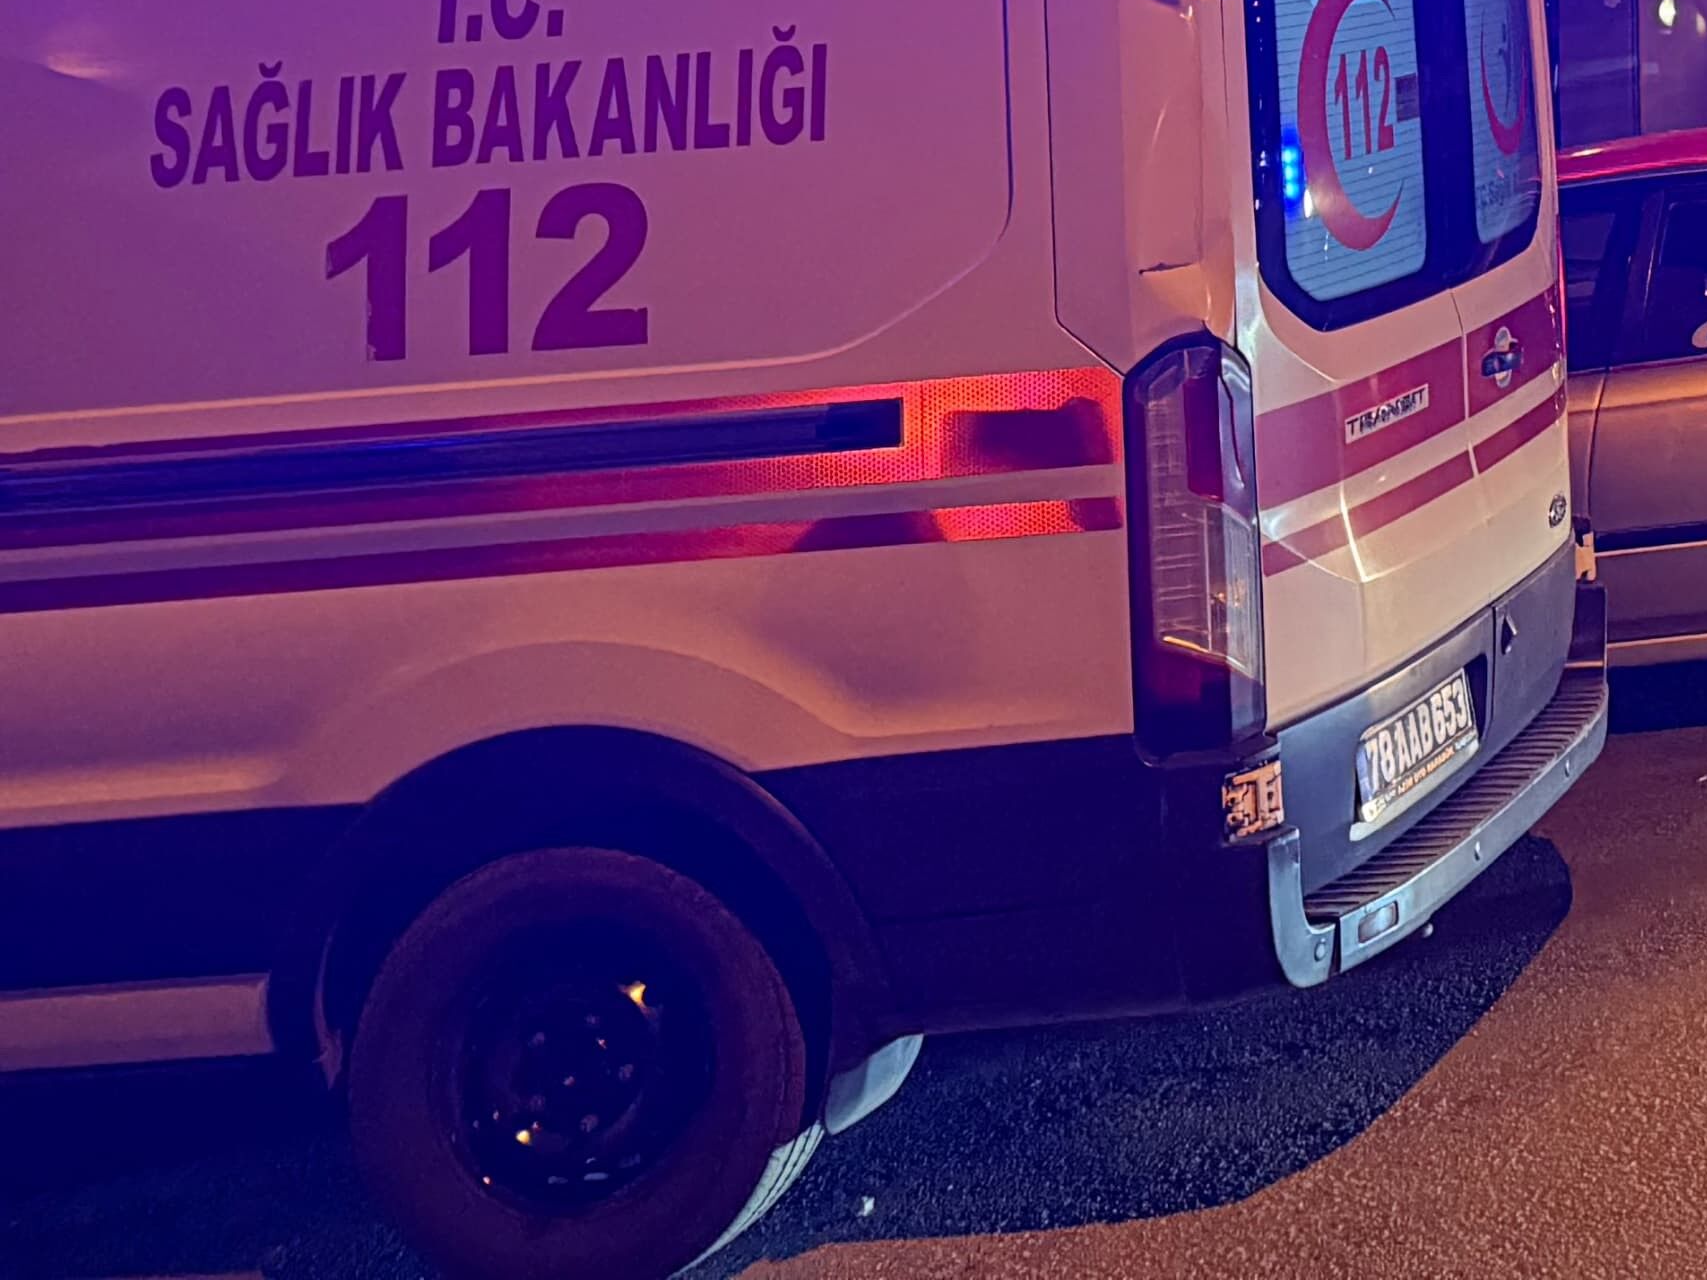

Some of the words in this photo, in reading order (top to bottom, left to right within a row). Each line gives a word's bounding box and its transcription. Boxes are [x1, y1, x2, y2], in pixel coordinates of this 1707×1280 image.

[150, 60, 408, 190] SAĞLIK
[432, 25, 828, 169] BAKANLIĞI
[1335, 45, 1395, 160] 112
[325, 183, 650, 363] 112
[1364, 730, 1395, 796] 78
[1394, 703, 1432, 772] AAB
[1430, 678, 1467, 744] 653
